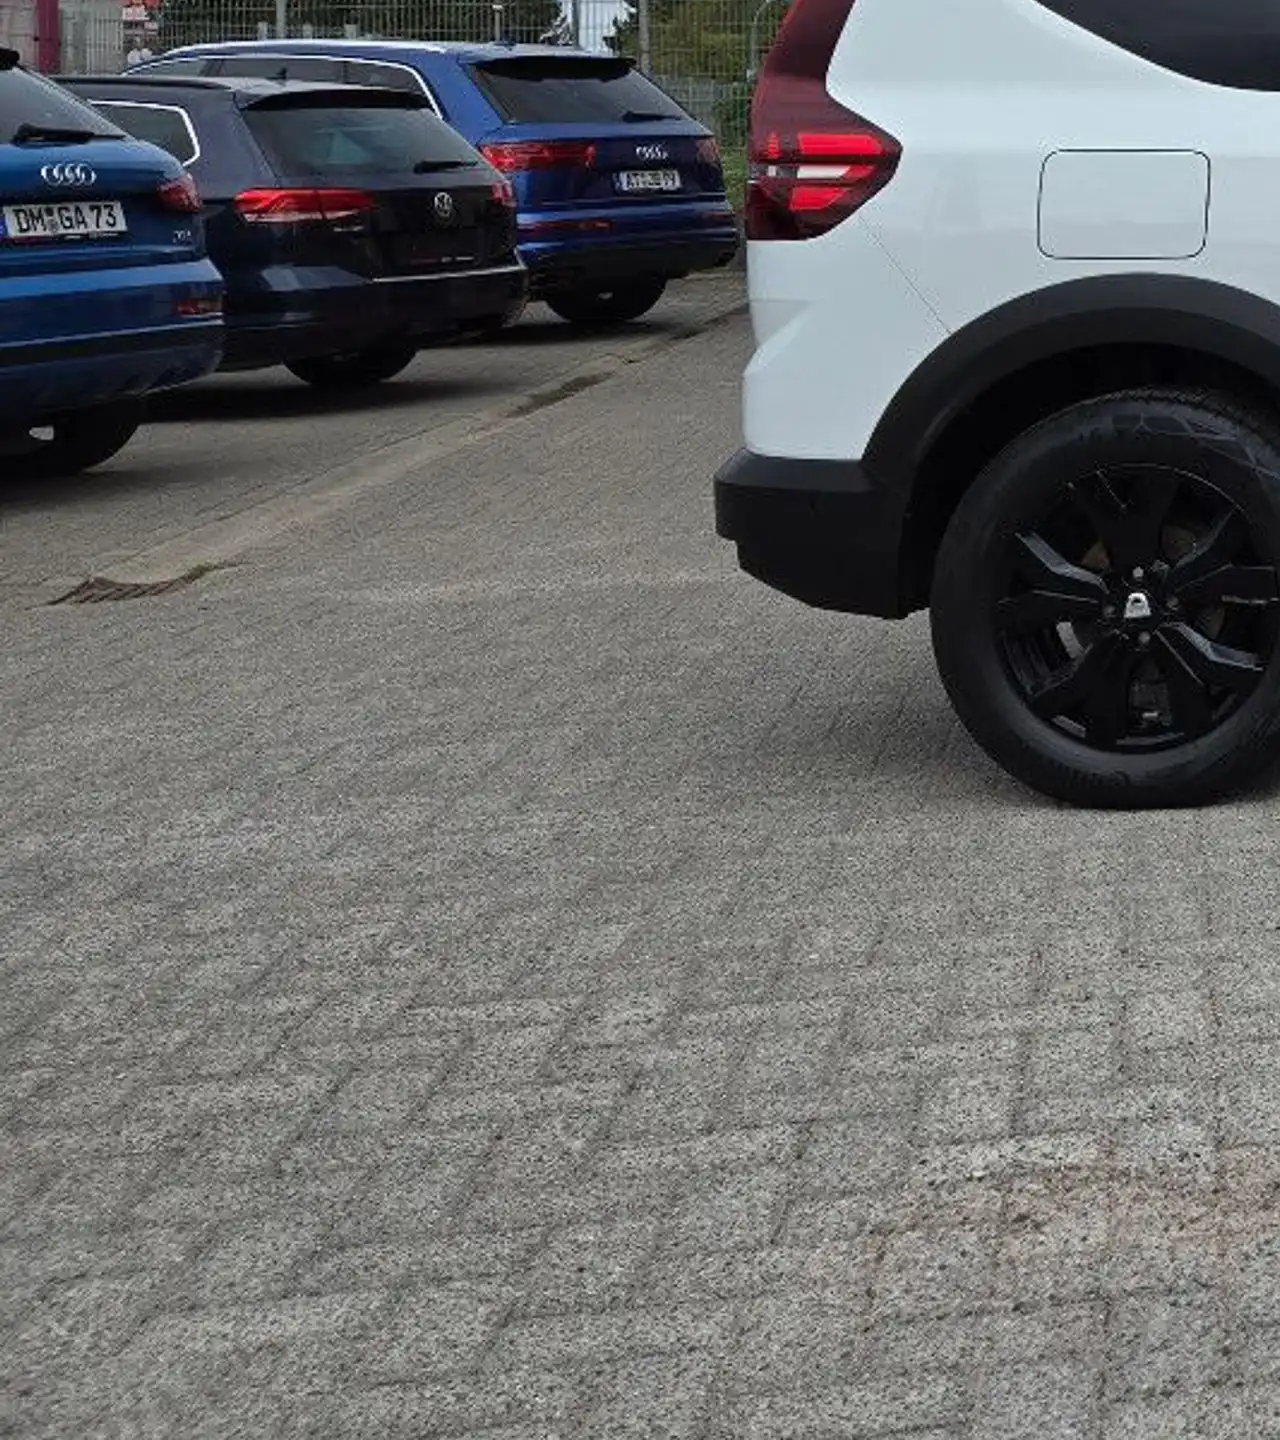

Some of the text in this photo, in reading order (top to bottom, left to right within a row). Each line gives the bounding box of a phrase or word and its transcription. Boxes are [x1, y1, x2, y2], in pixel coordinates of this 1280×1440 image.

[12, 204, 118, 233] DM GA 73
